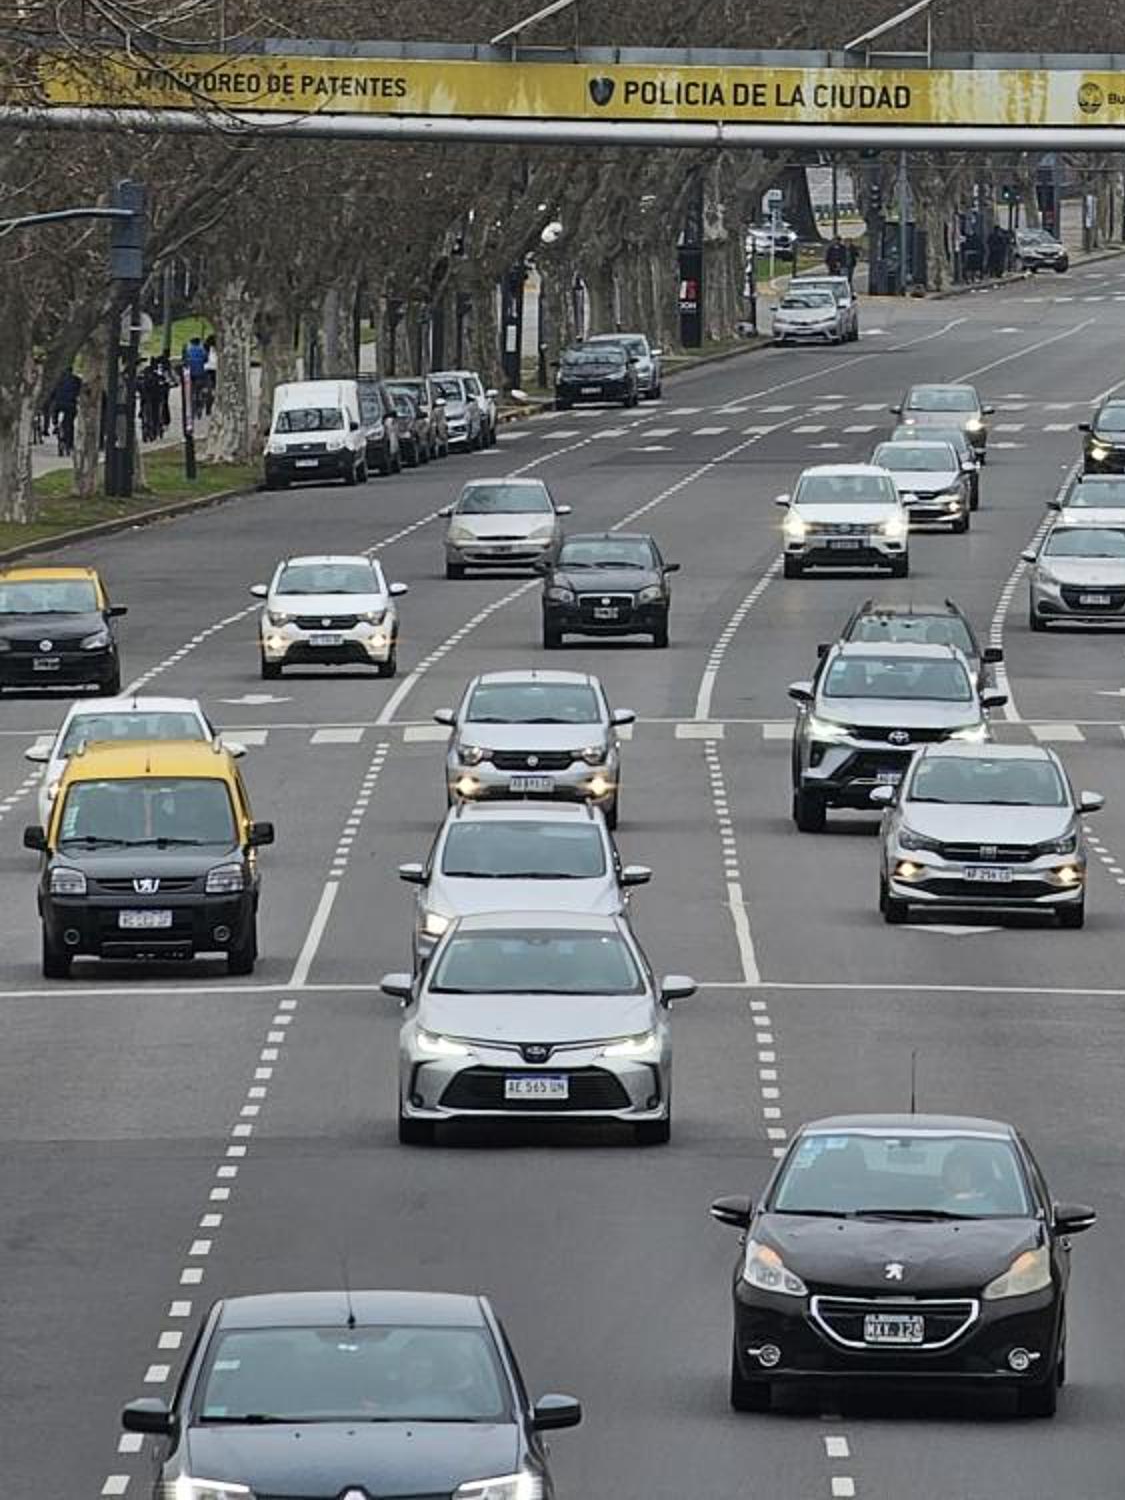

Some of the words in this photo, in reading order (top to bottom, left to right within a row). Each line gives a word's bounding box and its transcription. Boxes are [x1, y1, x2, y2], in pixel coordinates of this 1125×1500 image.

[267, 74, 294, 95] DE
[301, 75, 407, 97] PATENTES
[624, 81, 725, 106] POLICIA
[733, 83, 767, 106] DE
[775, 84, 806, 108] LA
[813, 84, 912, 109] CIUDAD
